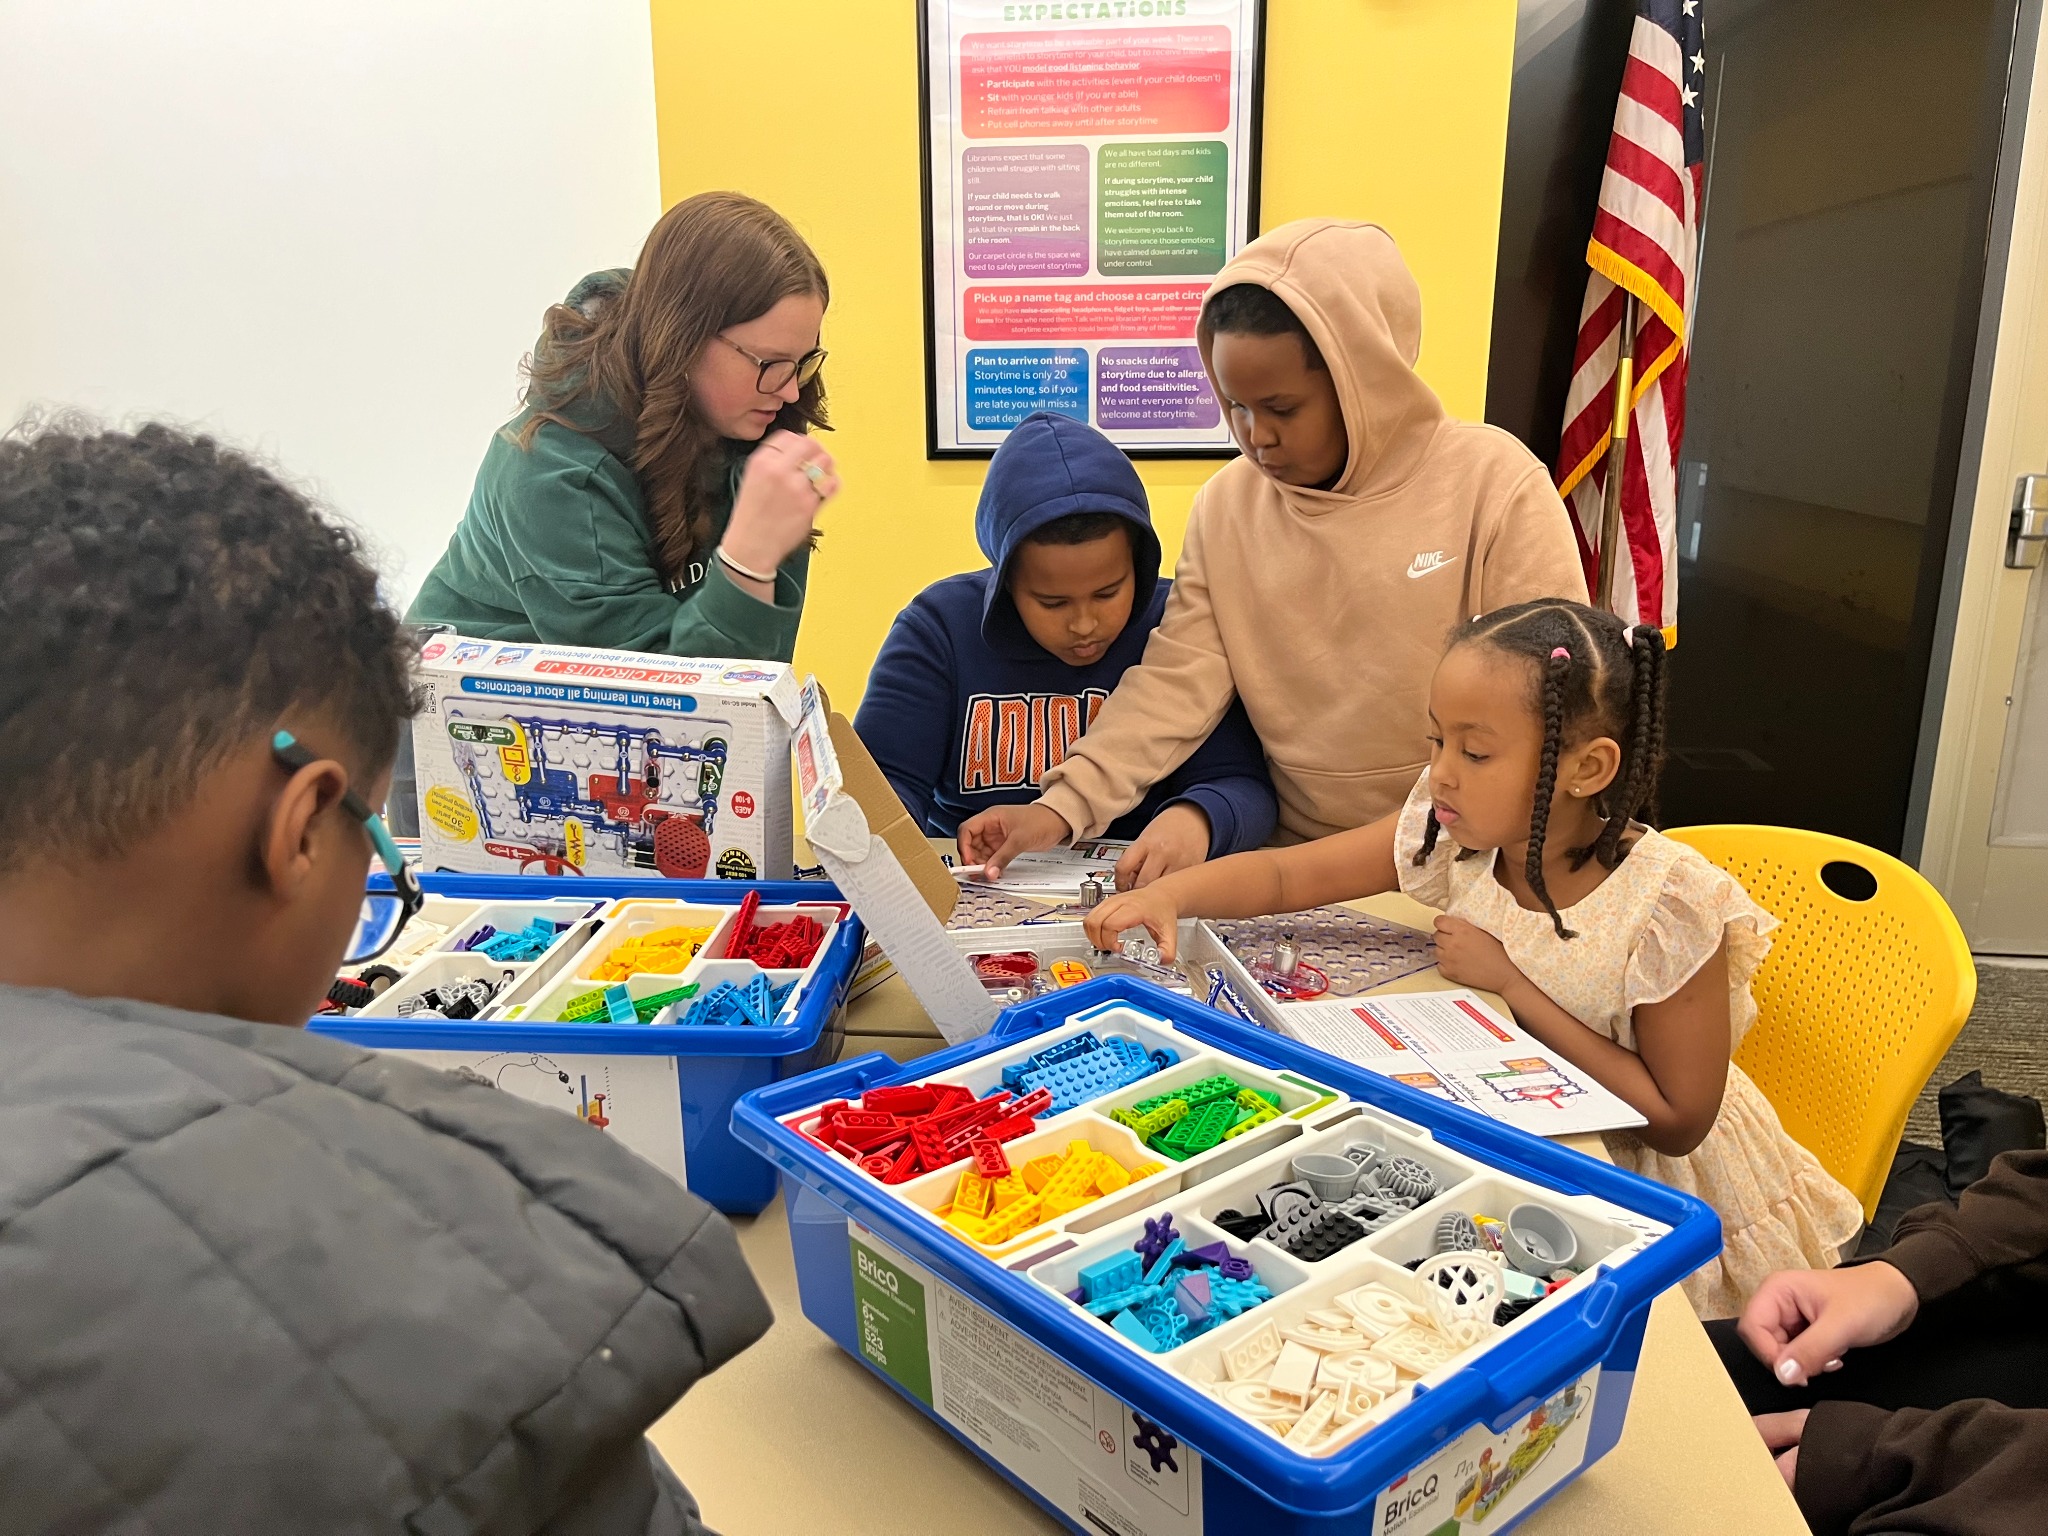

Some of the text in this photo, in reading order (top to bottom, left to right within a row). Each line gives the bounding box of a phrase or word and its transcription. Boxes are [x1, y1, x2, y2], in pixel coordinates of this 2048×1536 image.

[987, 80, 1035, 89] Participate
[1072, 77, 1109, 86] activities
[1112, 77, 1134, 85] (even
[1144, 77, 1162, 86] your
[1165, 75, 1184, 83] child
[1187, 74, 1220, 83] doesn't)
[1112, 177, 1135, 185] during
[1137, 177, 1175, 185] storytime,
[968, 215, 1006, 223] storytime,
[1059, 213, 1072, 222] just
[974, 293, 997, 303] Pick
[999, 294, 1012, 304] up
[1054, 293, 1072, 303] tag
[1074, 292, 1093, 301] and
[1096, 292, 1134, 301] choose
[1145, 291, 1180, 302] carpet
[1182, 290, 1205, 300] circl
[974, 356, 996, 366] Plan
[998, 357, 1008, 365] to
[1010, 356, 1038, 365] arrive
[1054, 356, 1079, 364] time.
[1101, 356, 1179, 366] No snacks during
[974, 370, 1067, 381] Storytime is only 20
[1101, 370, 1146, 380] storytime
[1178, 370, 1207, 379] allergi
[975, 385, 1012, 394] minutes
[1014, 385, 1036, 396] long,
[1052, 384, 1059, 393] if
[1060, 386, 1078, 395] you
[1101, 383, 1199, 392] and food sensitivities.
[992, 400, 1009, 408] late
[1011, 401, 1028, 410] you
[1030, 399, 1045, 408] will
[1047, 399, 1069, 408] miss
[1101, 397, 1116, 405] We
[1118, 397, 1140, 405] want
[1142, 398, 1182, 406] everyone
[1196, 396, 1212, 404] feel
[975, 414, 1022, 425] great deal
[1101, 410, 1140, 418] welcome
[1153, 410, 1197, 419] storytime.
[1414, 550, 1444, 568] NIKE
[540, 649, 592, 658] electronics
[636, 657, 677, 667] learning
[680, 661, 697, 669] fun
[699, 662, 724, 670] Have
[540, 661, 700, 685] SNAP CIRCUITS Jr.
[475, 681, 681, 710] Have fun learning all about electronics
[962, 690, 1107, 790] ADID
[736, 796, 751, 804] 8-108
[443, 804, 453, 812] your
[735, 806, 752, 814] AGES
[452, 818, 463, 827] 30
[445, 822, 465, 835] Contains
[722, 851, 750, 864] WINNER
[858, 1249, 898, 1294] BricQ
[863, 1306, 875, 1322] 6+
[949, 1295, 1009, 1340] AVERTISSEMENT
[864, 1329, 883, 1350] 523
[1385, 1474, 1438, 1527] BricQ
